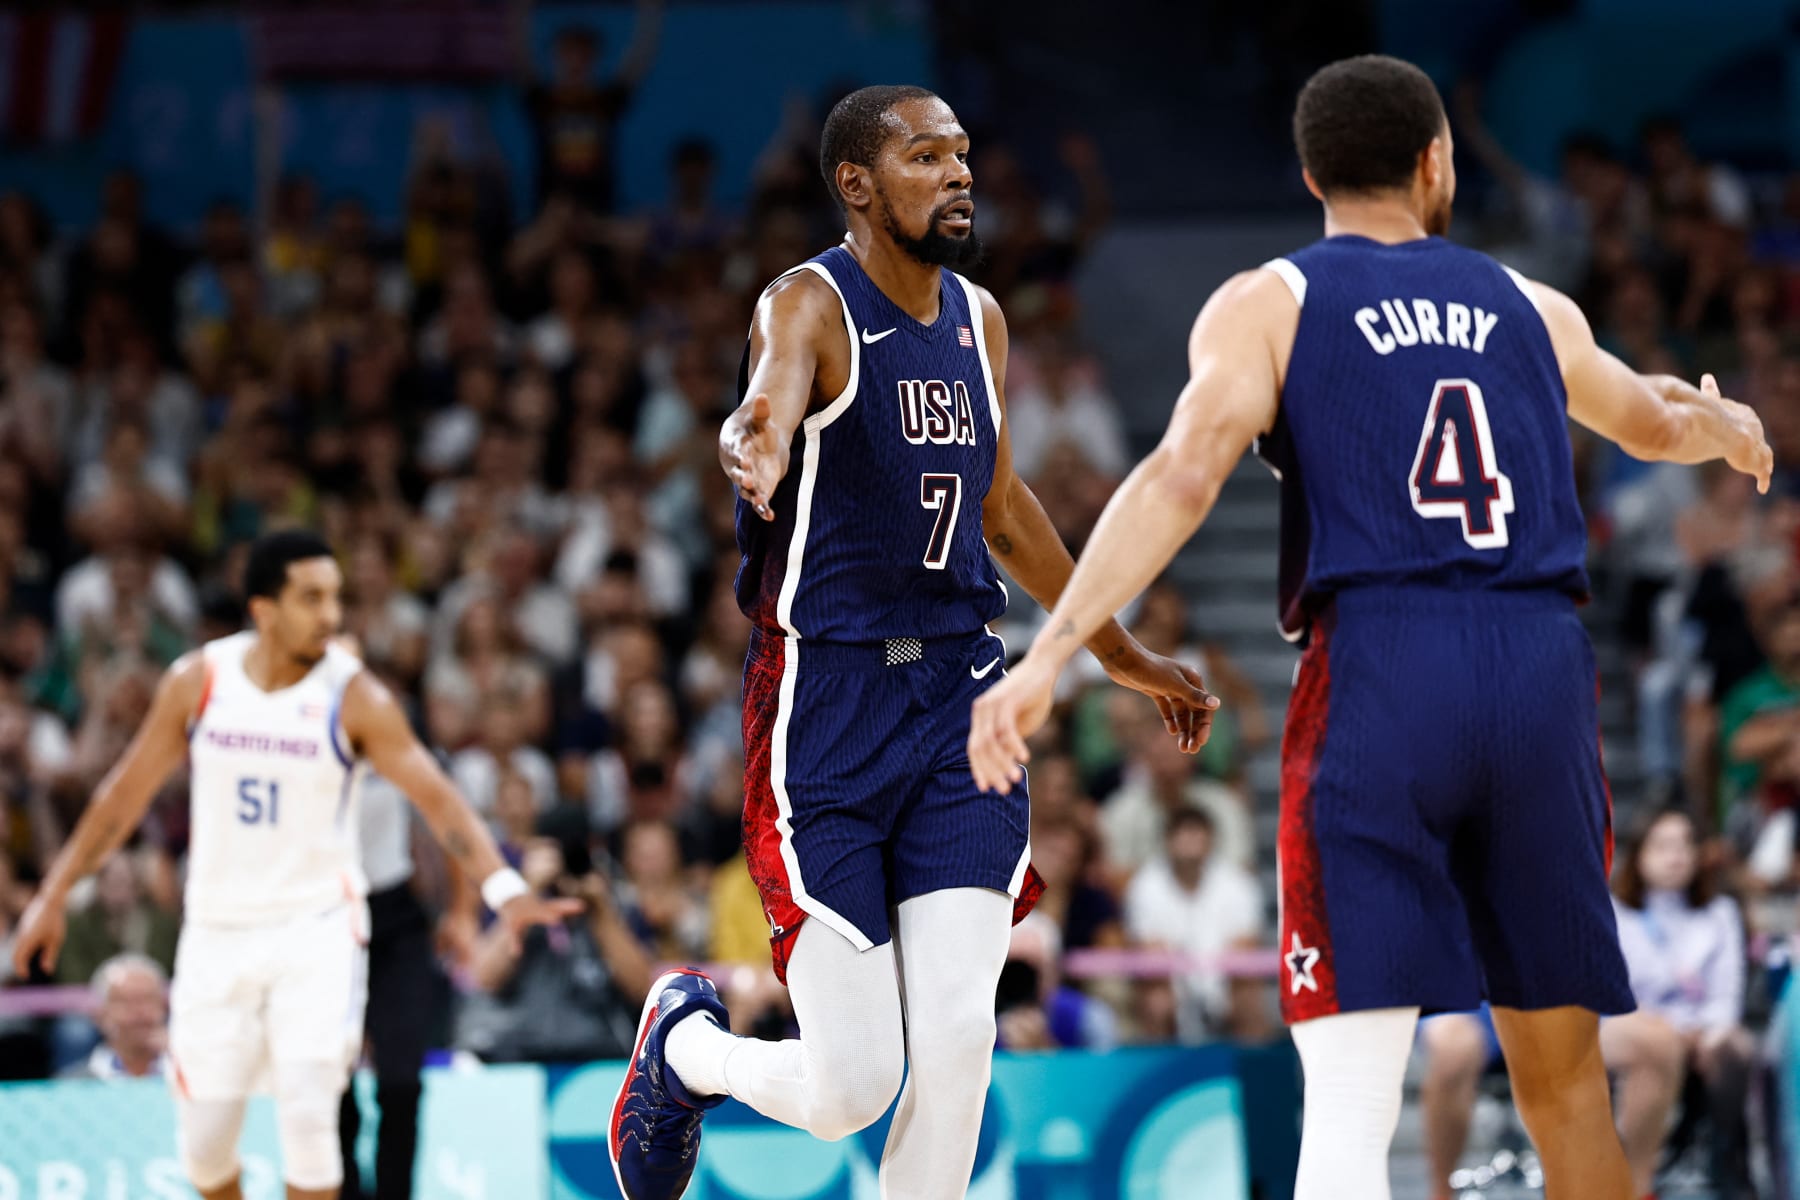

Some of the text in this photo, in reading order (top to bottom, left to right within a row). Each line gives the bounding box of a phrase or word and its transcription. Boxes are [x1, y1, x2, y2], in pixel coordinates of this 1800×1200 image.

[1354, 298, 1499, 354] CURRY
[898, 380, 976, 446] USA
[1408, 378, 1515, 550] 4
[921, 473, 961, 570] 7
[238, 777, 278, 826] 51
